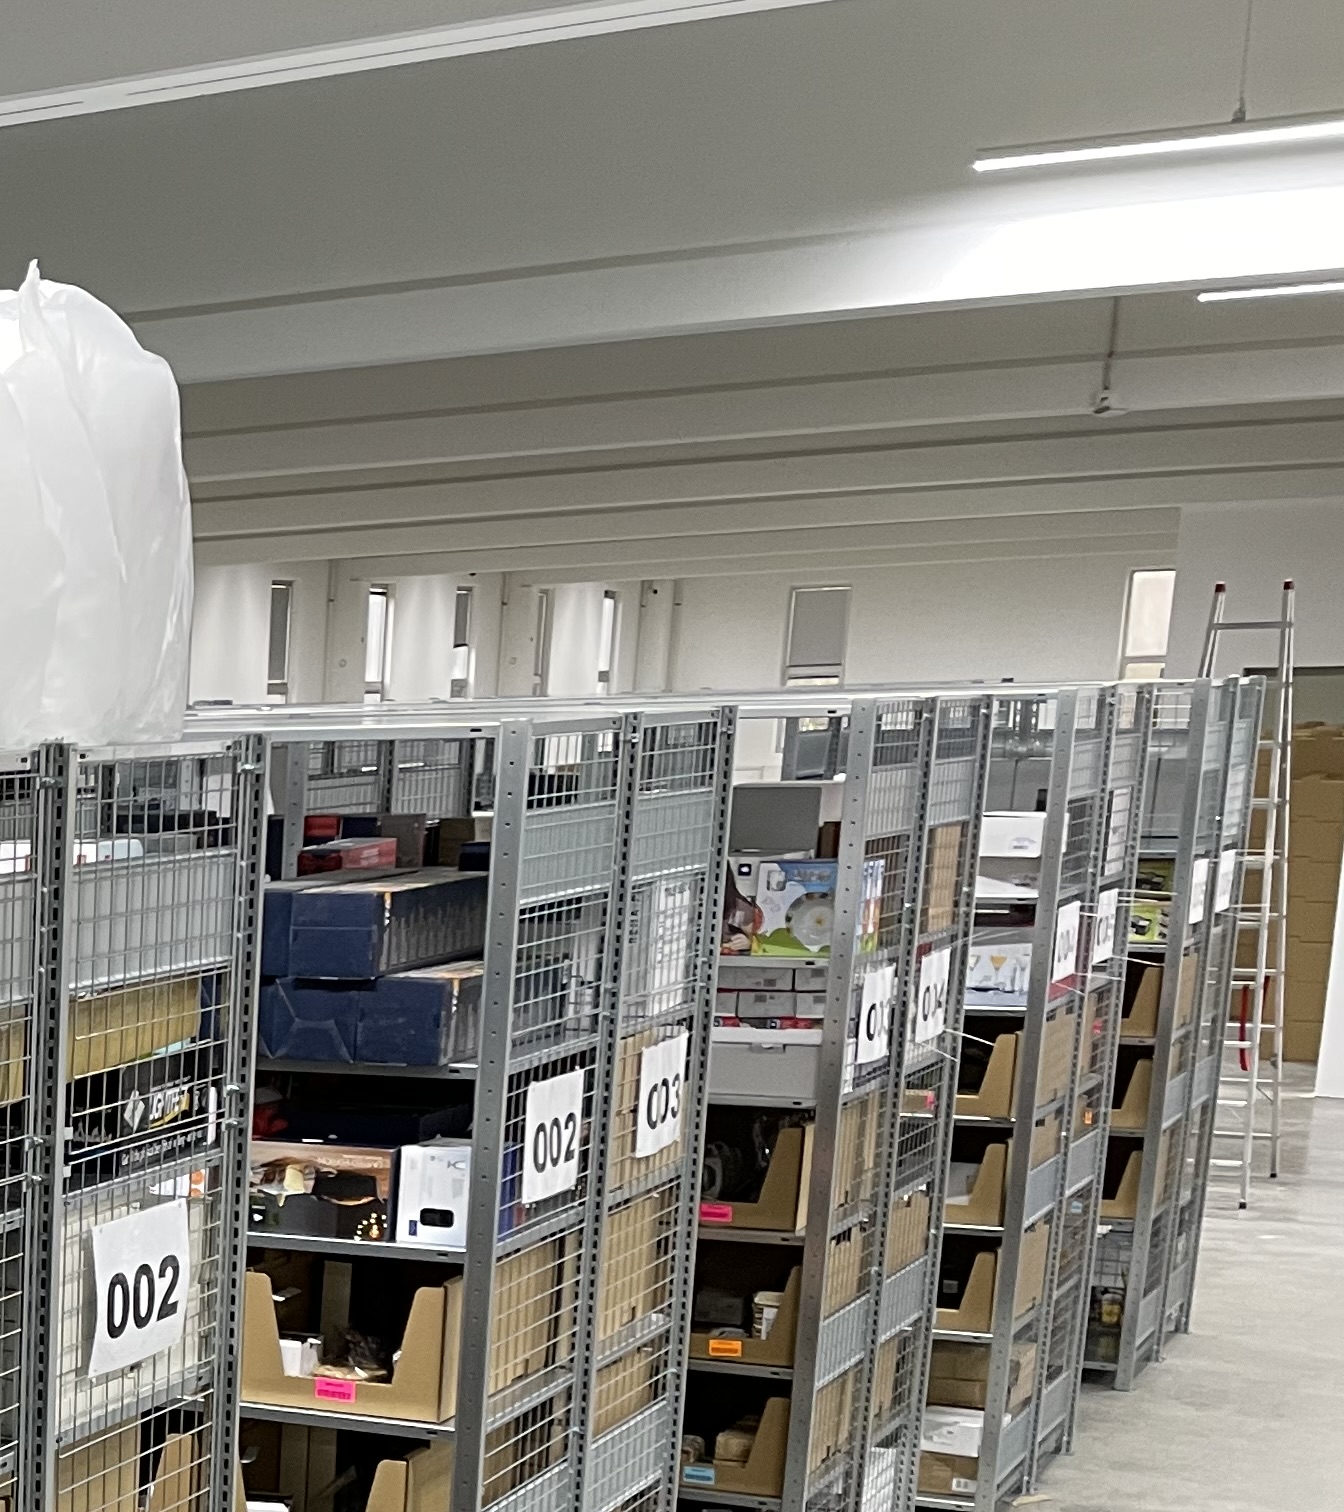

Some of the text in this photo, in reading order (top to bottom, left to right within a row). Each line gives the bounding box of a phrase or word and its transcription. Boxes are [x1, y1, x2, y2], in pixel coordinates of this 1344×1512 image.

[646, 1073, 681, 1130] 003
[533, 1112, 577, 1174] 002
[107, 1254, 181, 1340] 002
